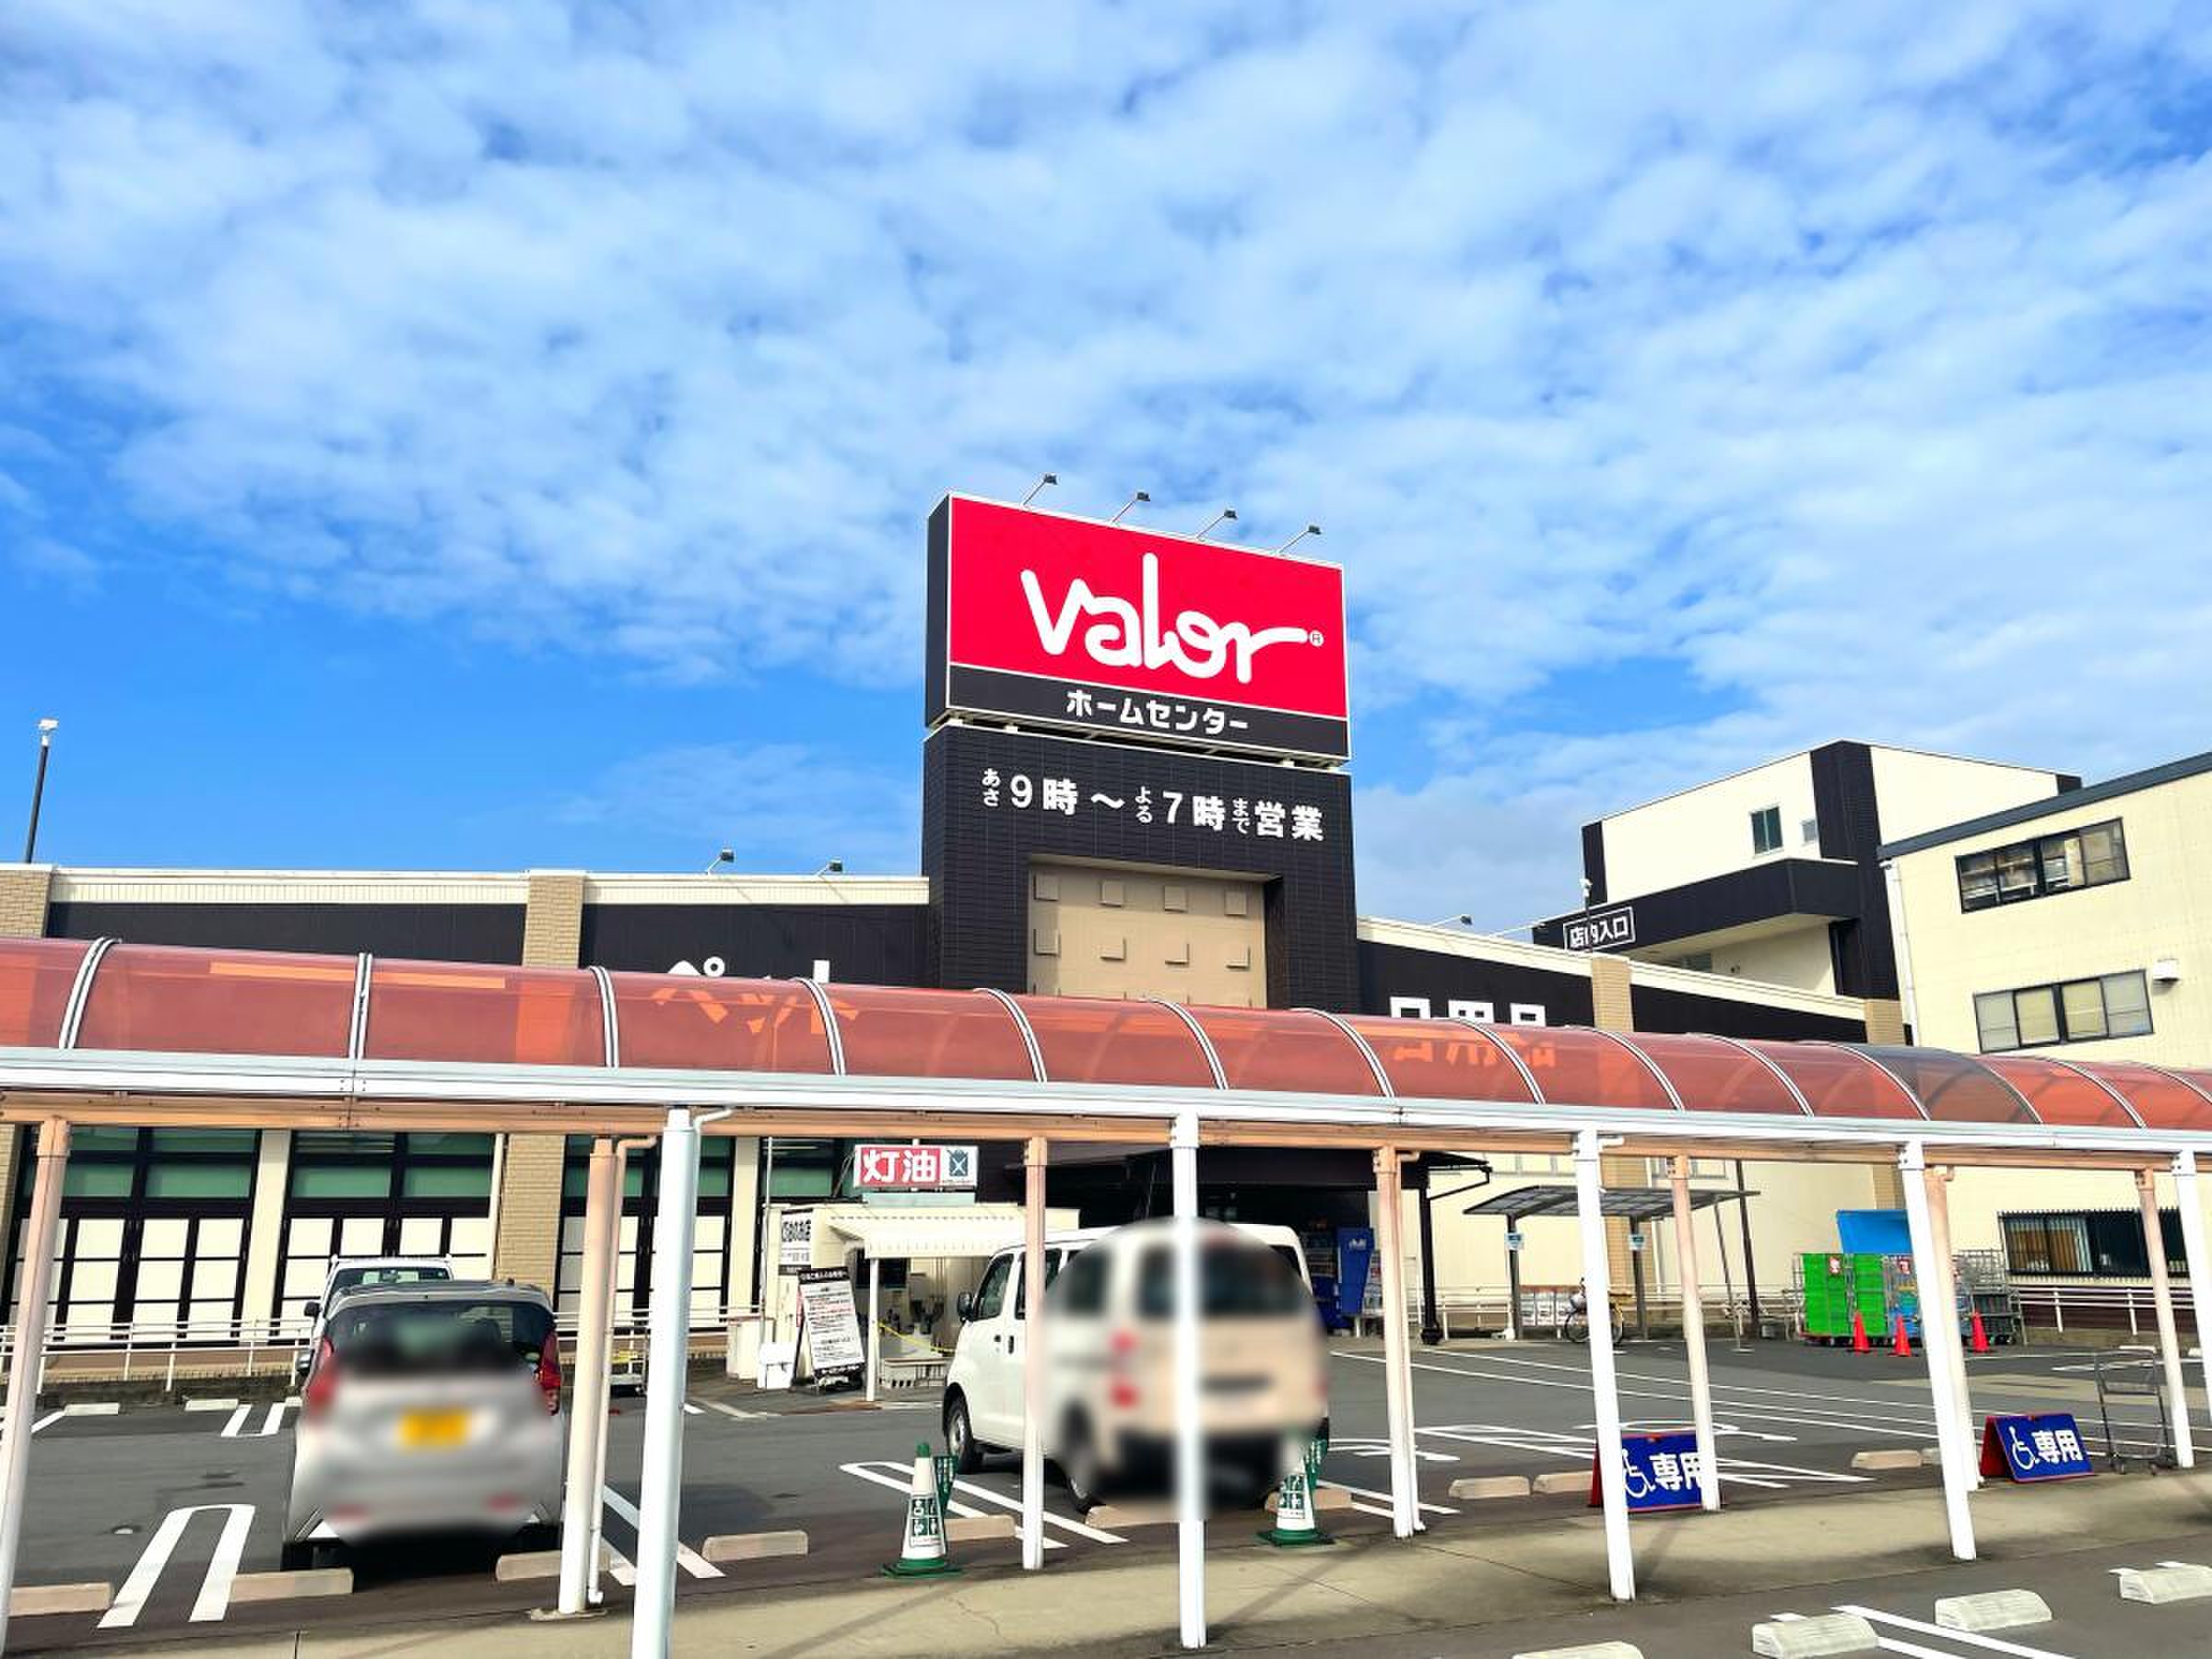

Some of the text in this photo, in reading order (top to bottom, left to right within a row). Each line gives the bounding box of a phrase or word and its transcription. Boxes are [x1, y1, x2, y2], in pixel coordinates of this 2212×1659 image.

[1066, 689, 1248, 735] ホームセンター
[1570, 916, 1629, 948] 店内入口
[863, 1149, 937, 1183] 灯油
[2031, 1430, 2083, 1464] 専用
